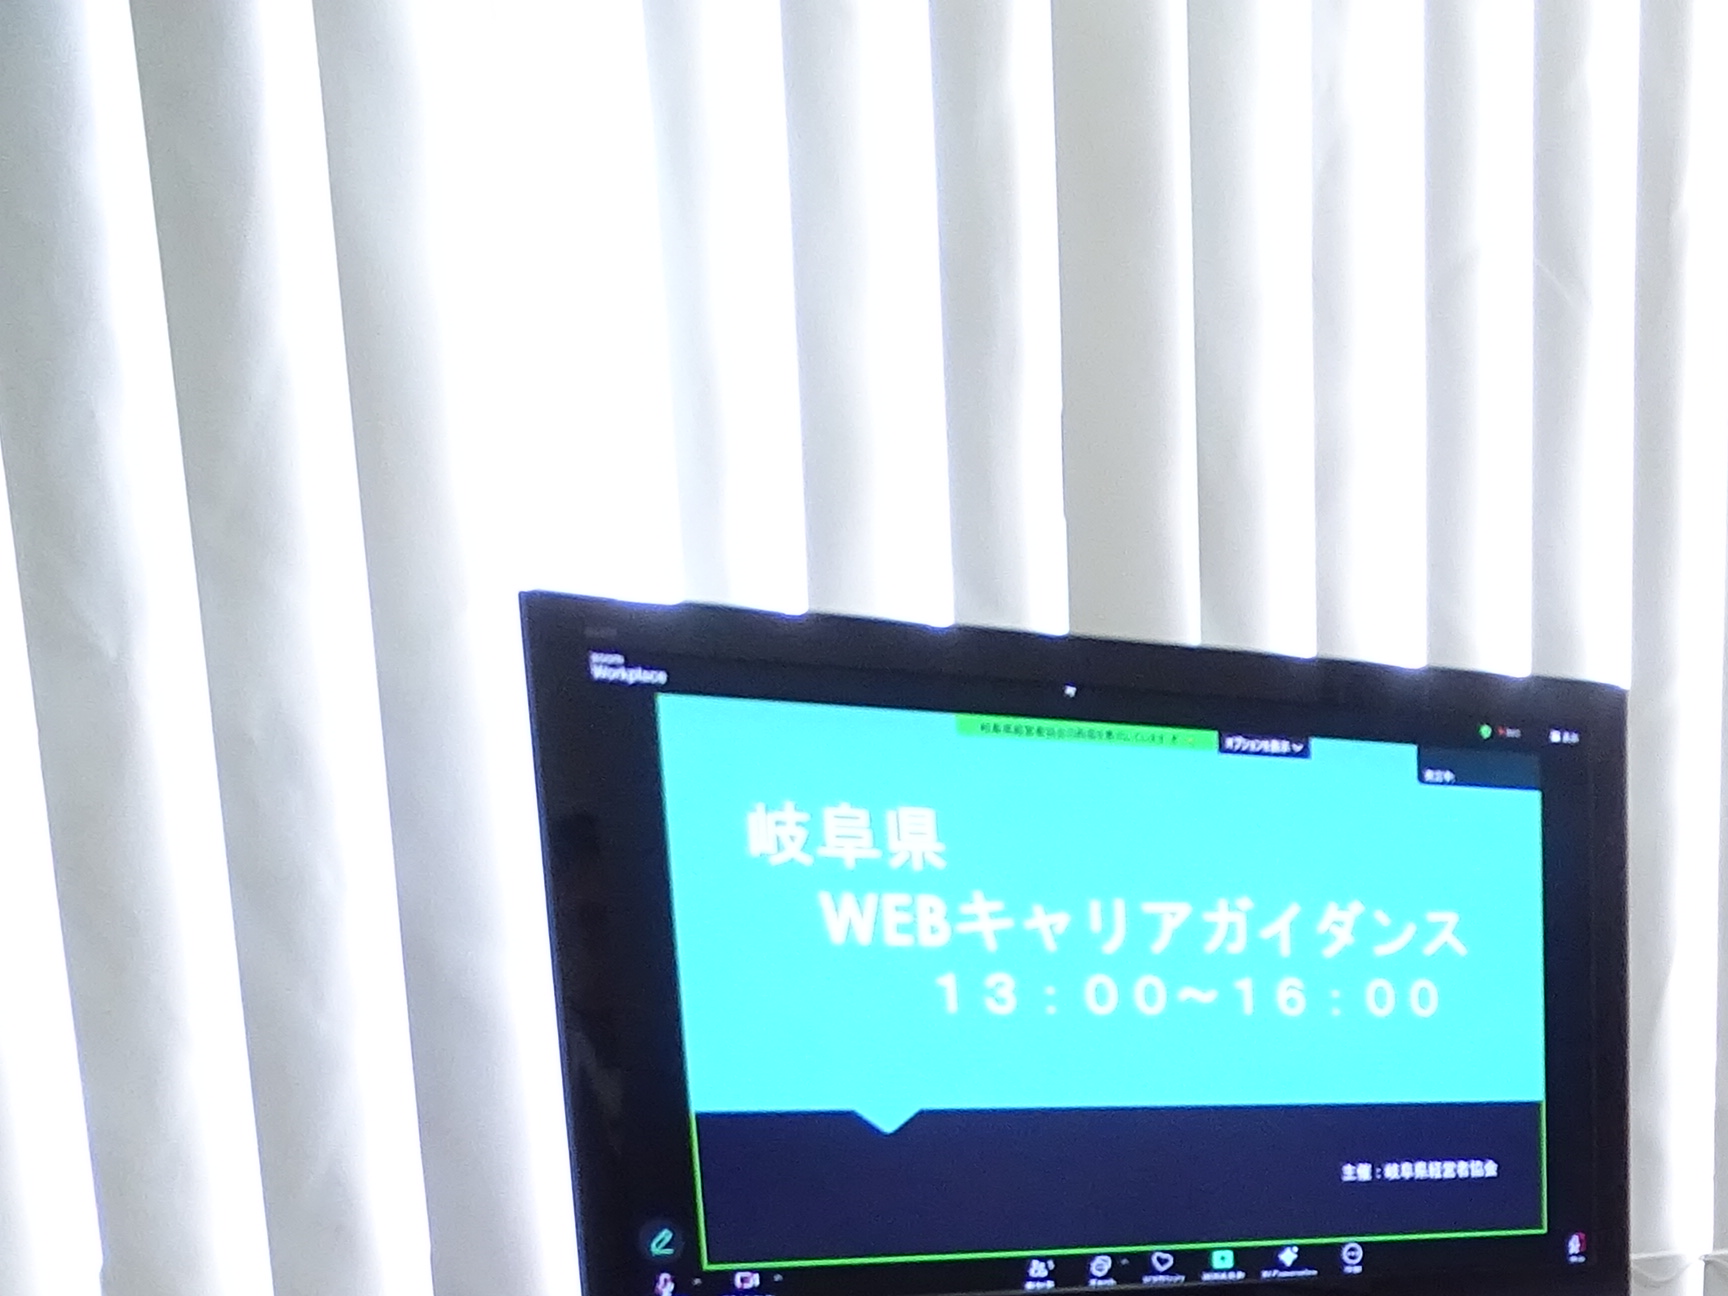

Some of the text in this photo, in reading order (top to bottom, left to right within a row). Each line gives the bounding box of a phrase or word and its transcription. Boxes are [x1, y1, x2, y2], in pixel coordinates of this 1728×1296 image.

[745, 801, 947, 871] 岐阜県
[817, 889, 1469, 958] WEBキャリアガイダンス
